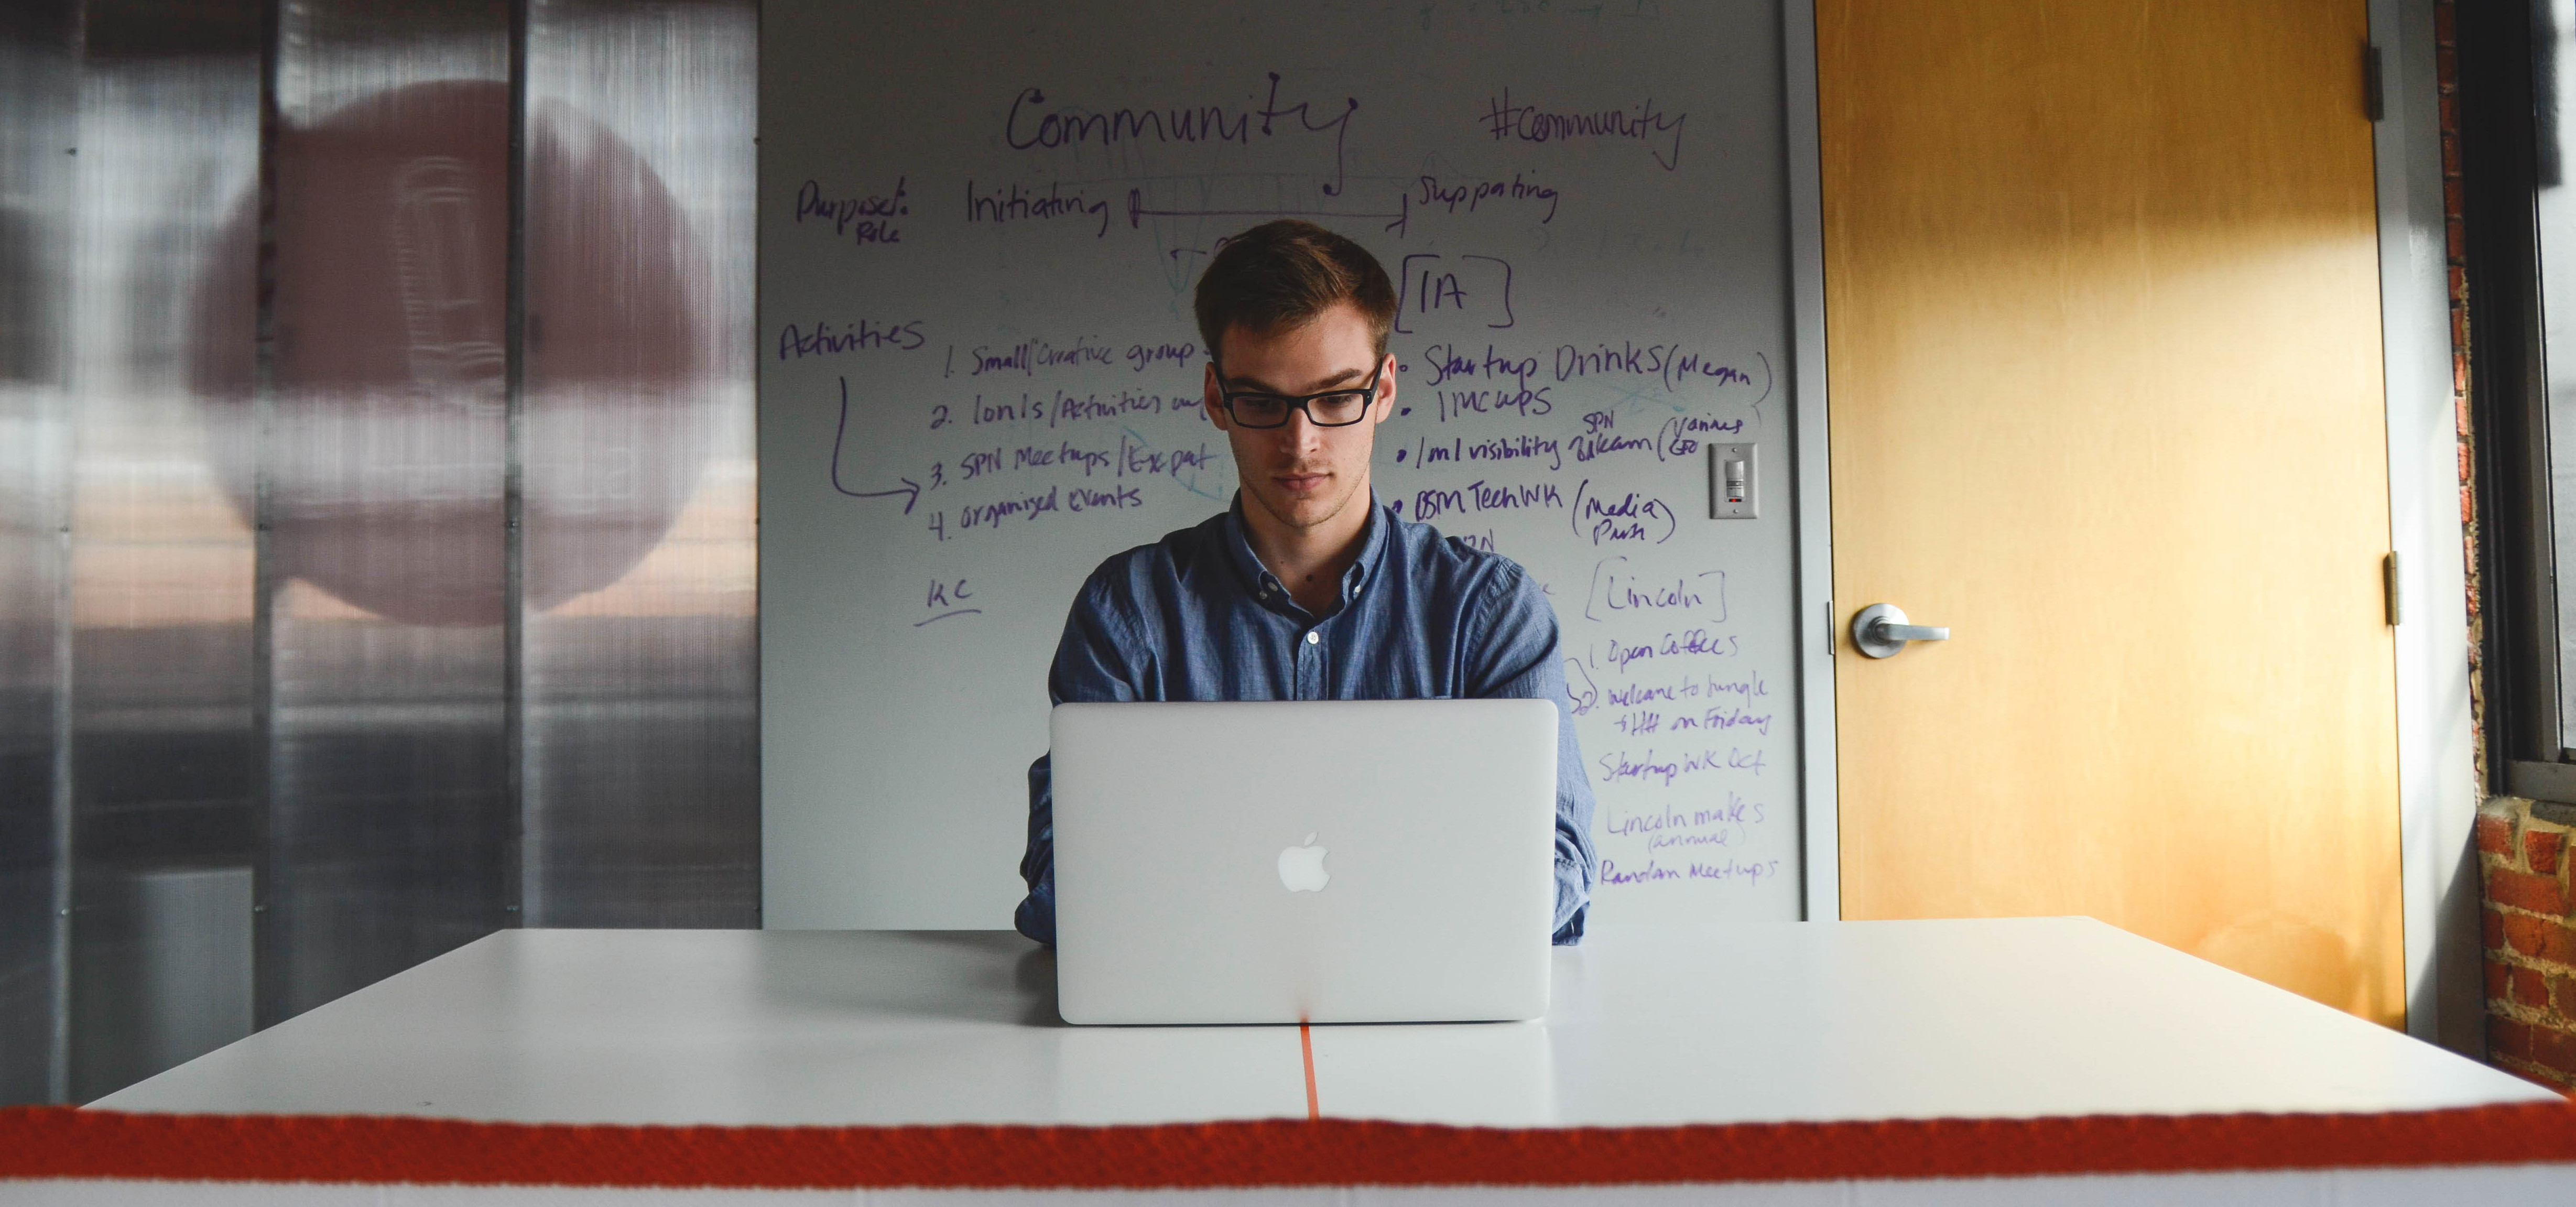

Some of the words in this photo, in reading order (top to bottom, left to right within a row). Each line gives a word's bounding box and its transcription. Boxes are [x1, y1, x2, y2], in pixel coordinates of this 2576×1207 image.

[1007, 71, 1358, 197] Community
[968, 181, 1109, 237] Initiating
[779, 319, 926, 360] Activities
[1426, 343, 1538, 388] Startup
[1583, 410, 1615, 434] SPN
[960, 447, 1002, 481] SPN
[1469, 435, 1562, 471] visibility
[928, 511, 953, 542] 4.
[1608, 639, 1653, 675] Open
[1680, 675, 1699, 699] to
[1703, 705, 1773, 736] Friday
[1599, 748, 1678, 787] Startup
[1728, 746, 1767, 776] Oct
[1607, 803, 1687, 836] Lincoln
[1600, 858, 1681, 886] Random
[1689, 857, 1780, 887] Meetups
